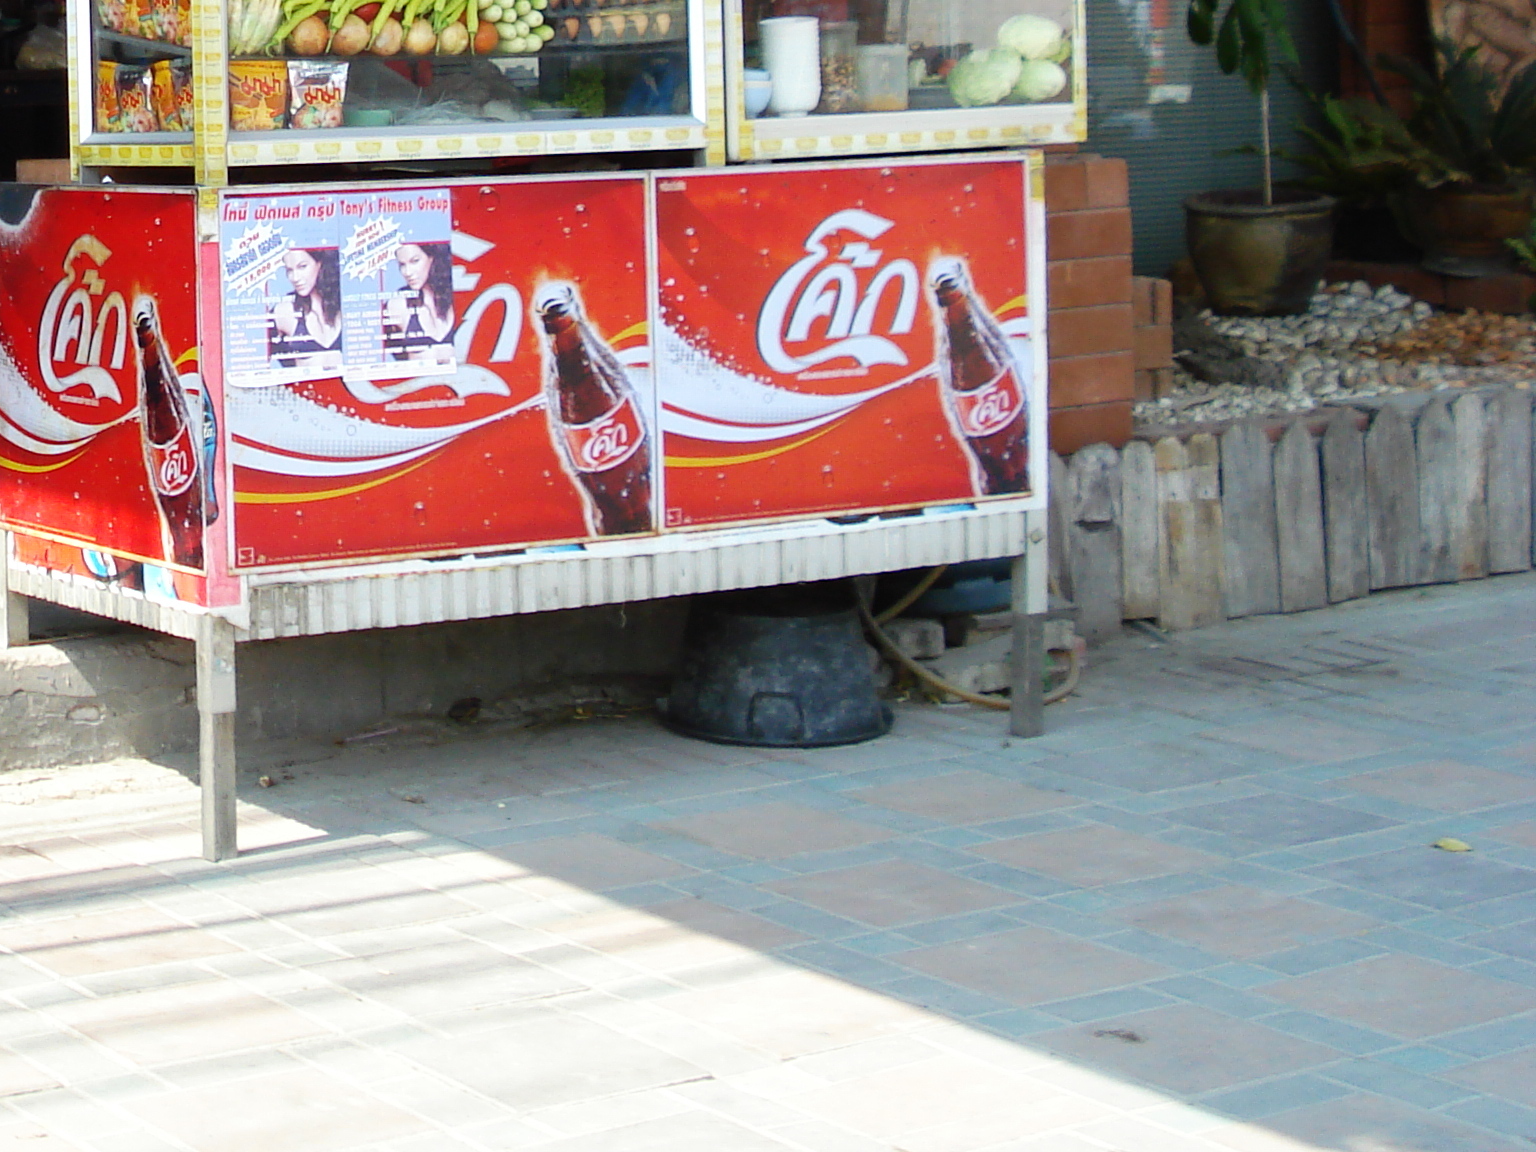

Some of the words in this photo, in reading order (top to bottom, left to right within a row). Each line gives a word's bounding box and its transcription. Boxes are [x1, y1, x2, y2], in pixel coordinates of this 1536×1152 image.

[340, 198, 373, 218] Tony's
[378, 196, 413, 213] Fitness
[418, 196, 448, 213] Group
[756, 208, 920, 375] โค้ก
